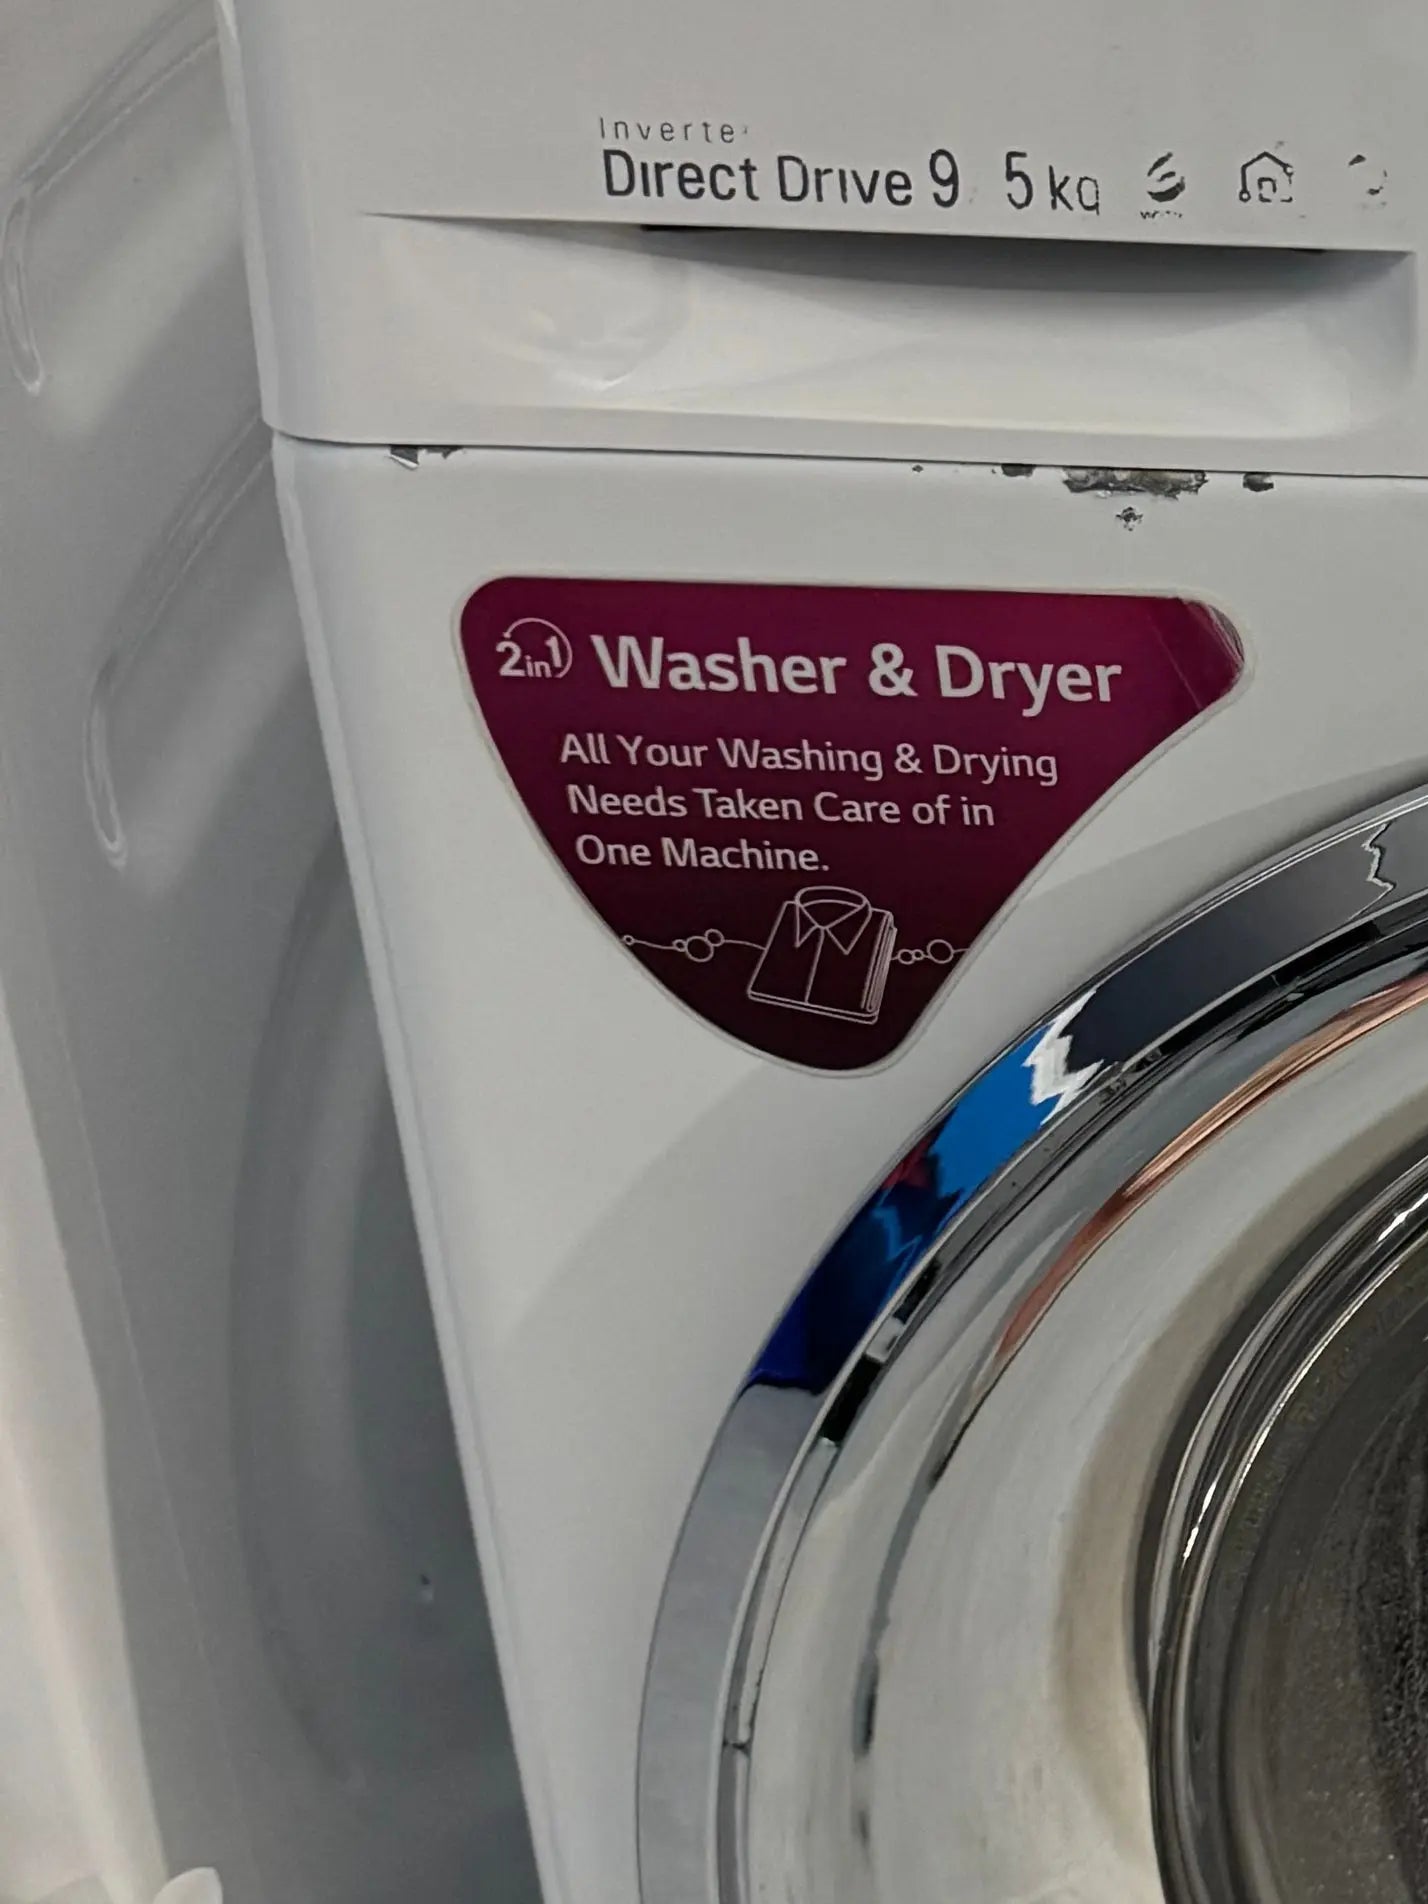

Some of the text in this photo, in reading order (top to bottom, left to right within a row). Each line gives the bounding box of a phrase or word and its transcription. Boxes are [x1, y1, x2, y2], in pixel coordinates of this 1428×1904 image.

[599, 117, 749, 143] Inverte
[603, 149, 759, 201] Direct
[778, 156, 912, 206] Drive
[591, 634, 848, 694] Washer
[870, 642, 914, 696] &
[939, 644, 1123, 718] Dryer
[560, 733, 1058, 785] All Your Washing & Drying
[568, 784, 995, 827] Needs Taken Care of in
[575, 835, 830, 873] One Machine.
